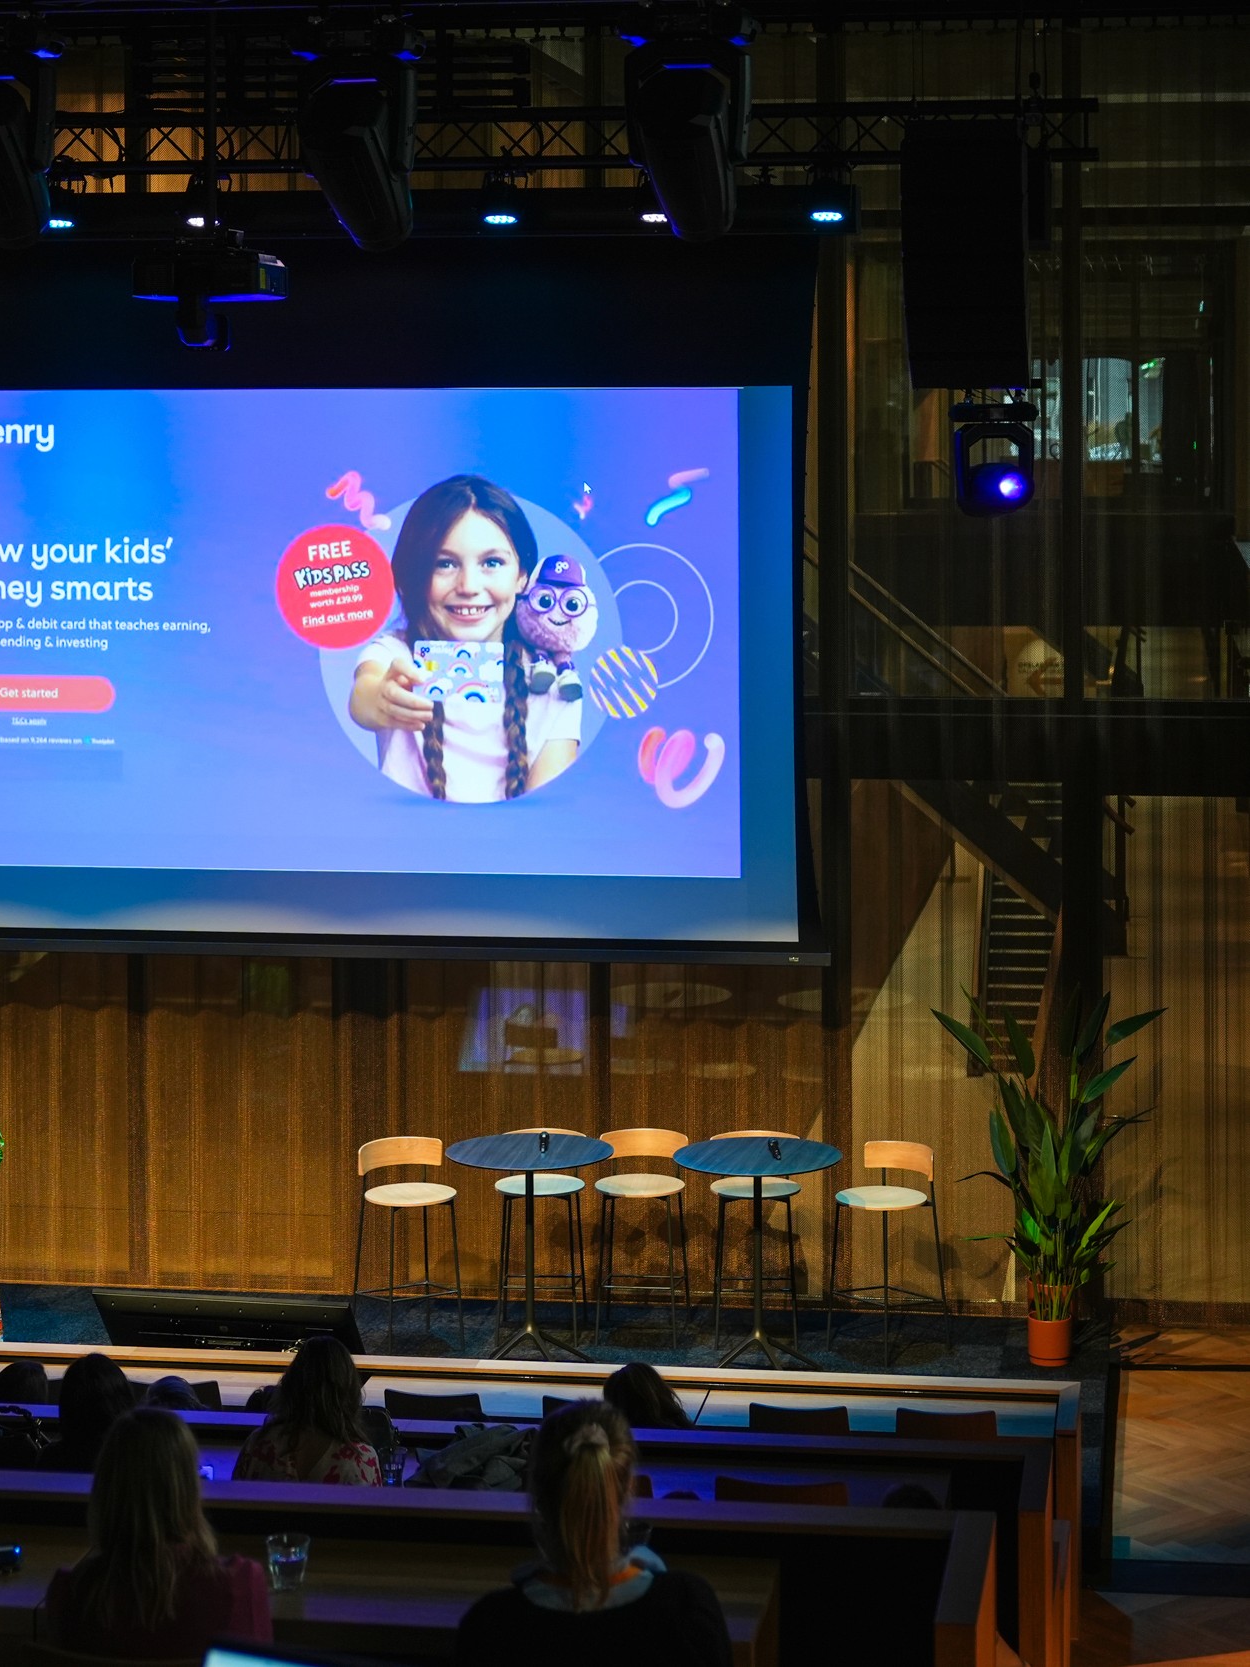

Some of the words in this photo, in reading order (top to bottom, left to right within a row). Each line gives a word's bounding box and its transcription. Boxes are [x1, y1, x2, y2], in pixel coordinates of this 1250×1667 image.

[31, 544, 97, 570] your
[307, 540, 352, 562] FREE
[50, 576, 153, 601] smarts
[309, 584, 360, 598] membership
[309, 598, 334, 609] worth
[16, 617, 25, 629] &
[27, 617, 58, 630] debit
[60, 618, 86, 630] card
[88, 618, 112, 630] that
[115, 618, 160, 631] teaches
[162, 620, 211, 634] earning,
[302, 615, 325, 627] Find
[327, 612, 345, 624] out
[347, 609, 374, 621] more
[44, 636, 53, 648] &
[56, 636, 109, 651] investing
[0, 687, 19, 698] Get
[21, 688, 59, 699] started
